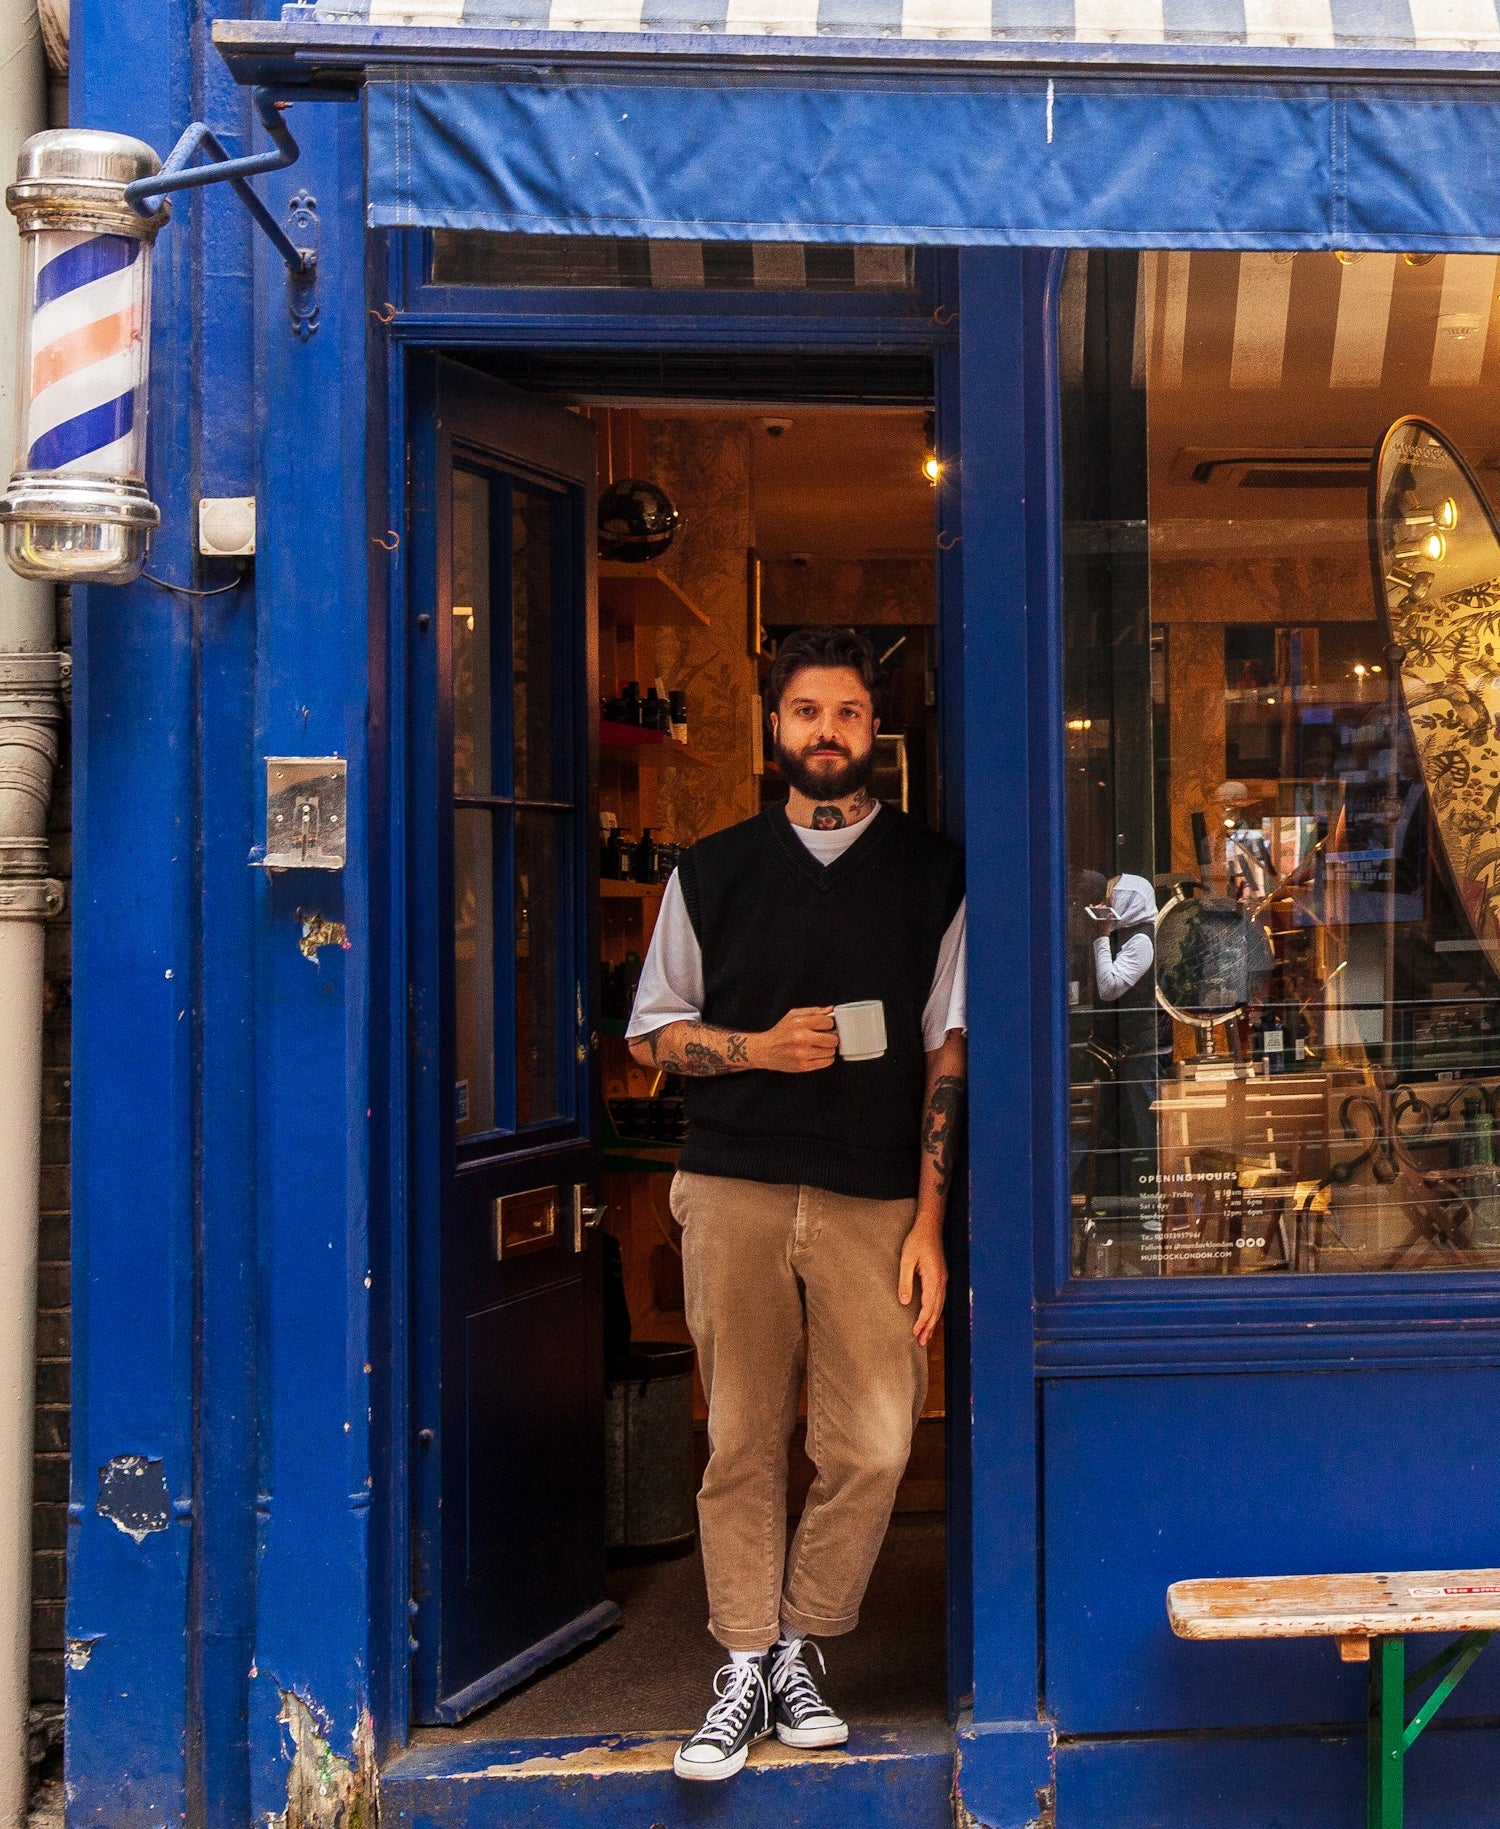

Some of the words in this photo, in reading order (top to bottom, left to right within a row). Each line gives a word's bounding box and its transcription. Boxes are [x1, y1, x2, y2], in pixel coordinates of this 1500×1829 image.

[1139, 1174, 1193, 1184] OPENING
[1197, 1172, 1238, 1181] HOURS
[1141, 1251, 1232, 1261] MURDOCKLONDON.COM
